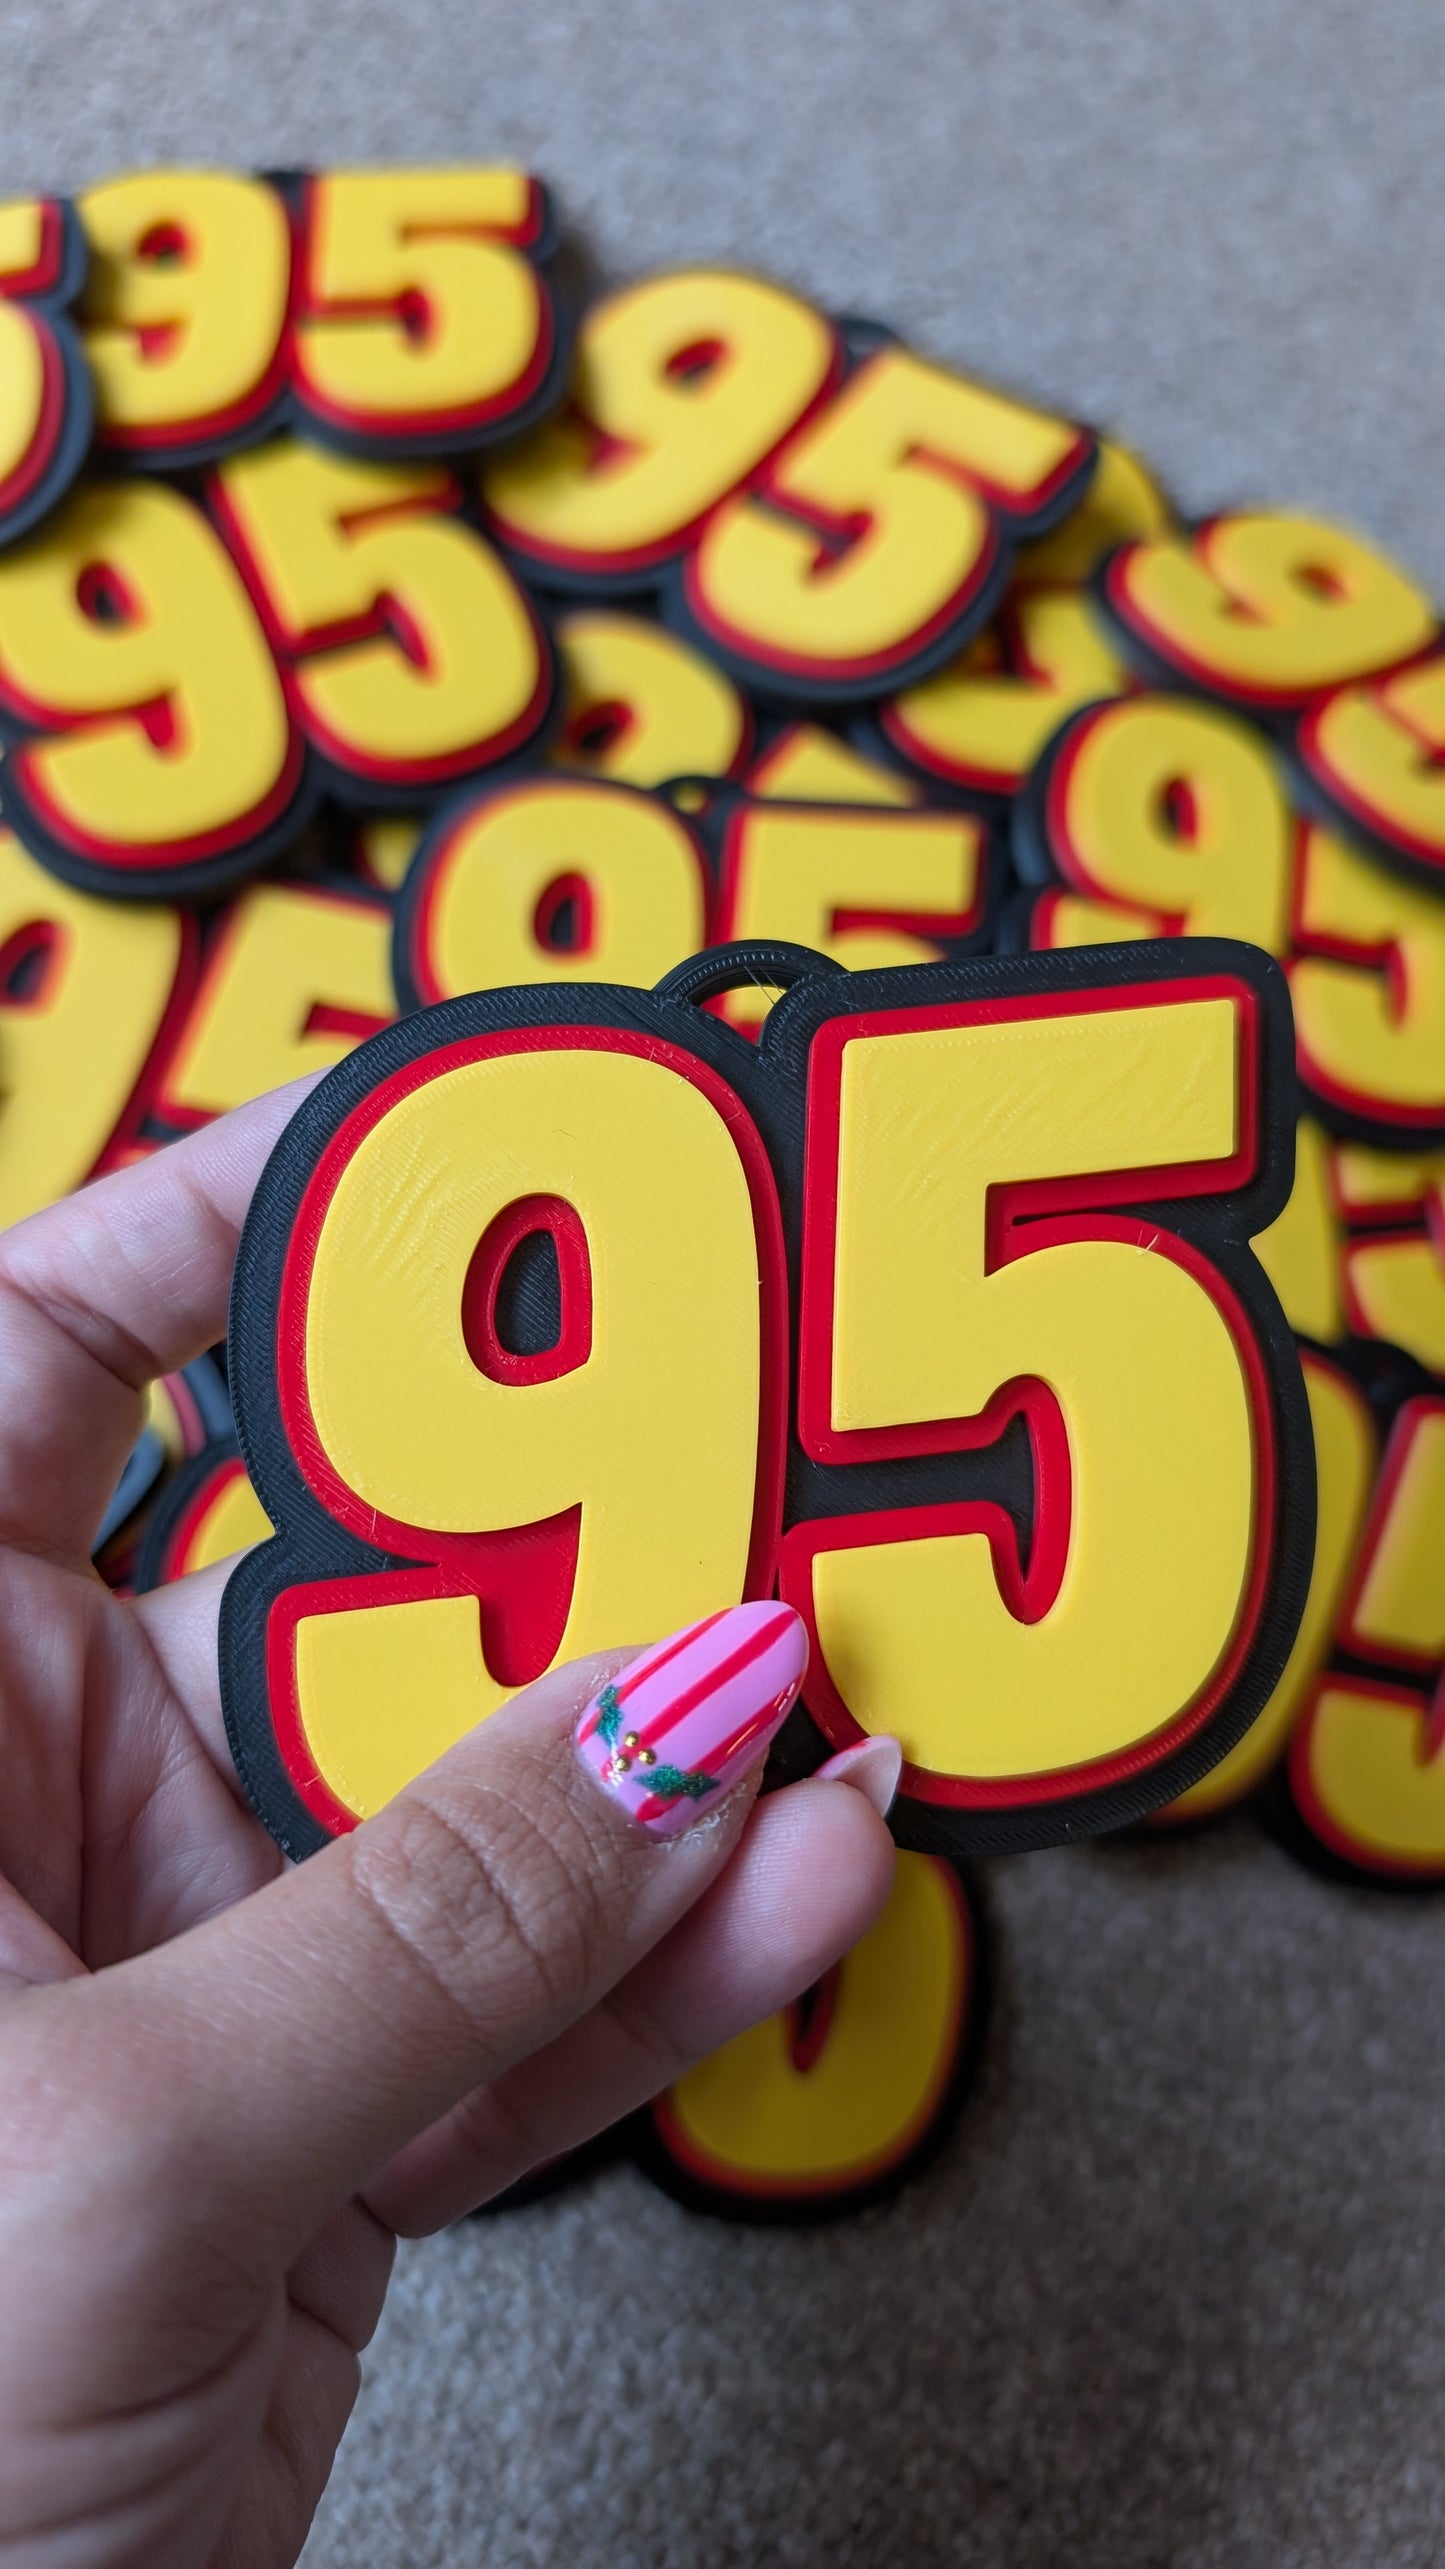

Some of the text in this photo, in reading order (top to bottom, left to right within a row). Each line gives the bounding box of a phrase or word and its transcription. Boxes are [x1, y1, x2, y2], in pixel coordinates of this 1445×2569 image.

[76, 164, 550, 428] 95
[484, 267, 1092, 675] 95
[0, 448, 548, 850] 95
[285, 988, 1265, 1824] 95
